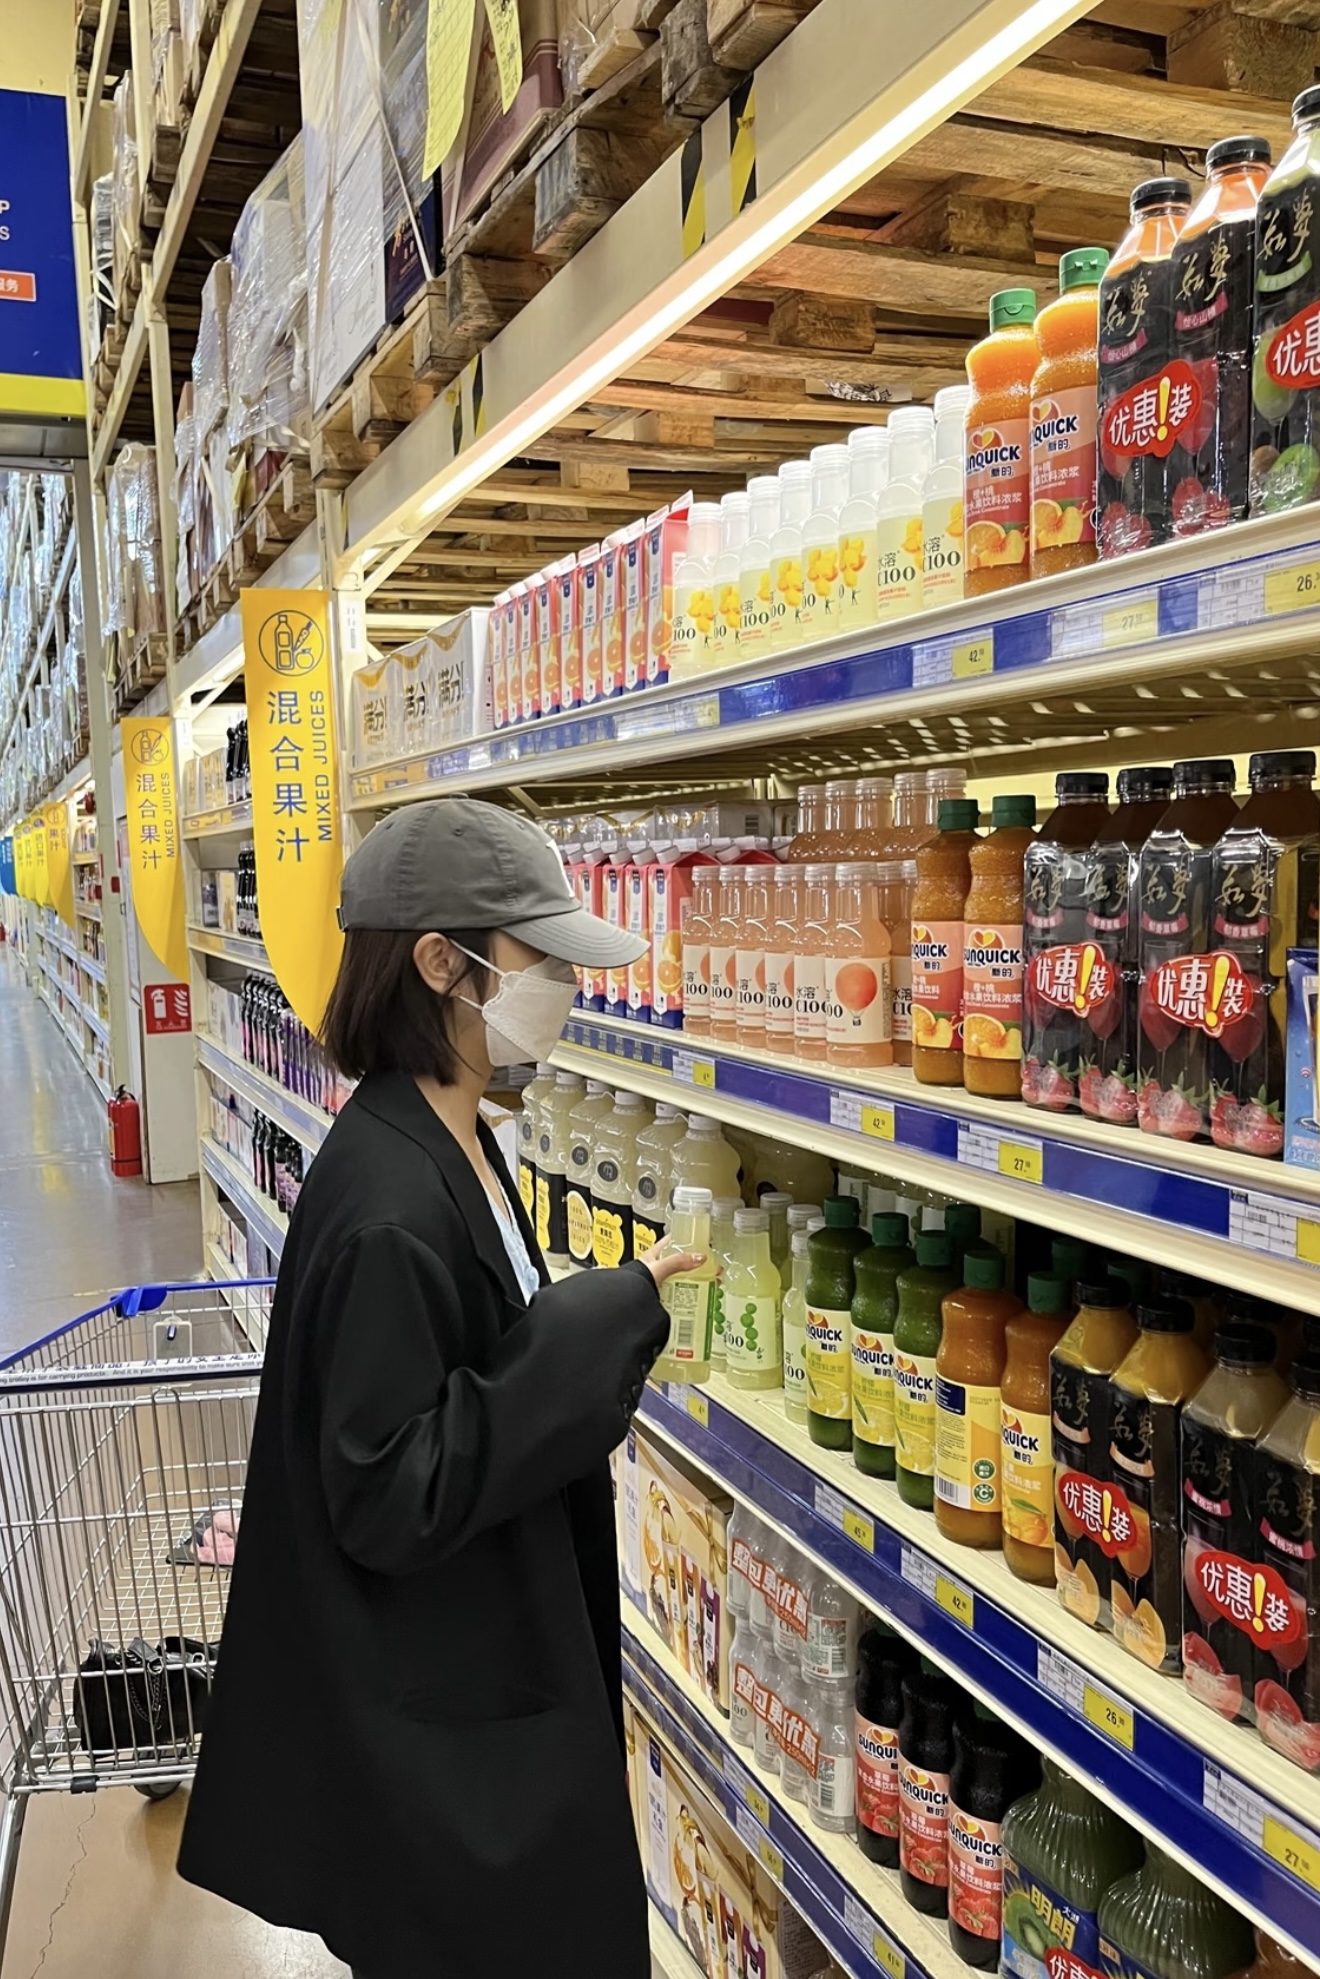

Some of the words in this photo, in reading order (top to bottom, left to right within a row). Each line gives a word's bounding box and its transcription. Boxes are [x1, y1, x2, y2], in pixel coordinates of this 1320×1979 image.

[309, 690, 328, 764] JUICES
[160, 772, 173, 815] JUICES
[267, 690, 311, 863] 混合果汁
[314, 773, 334, 842] MIXED
[135, 773, 163, 870] 混合果汁
[164, 818, 176, 859] MIXED
